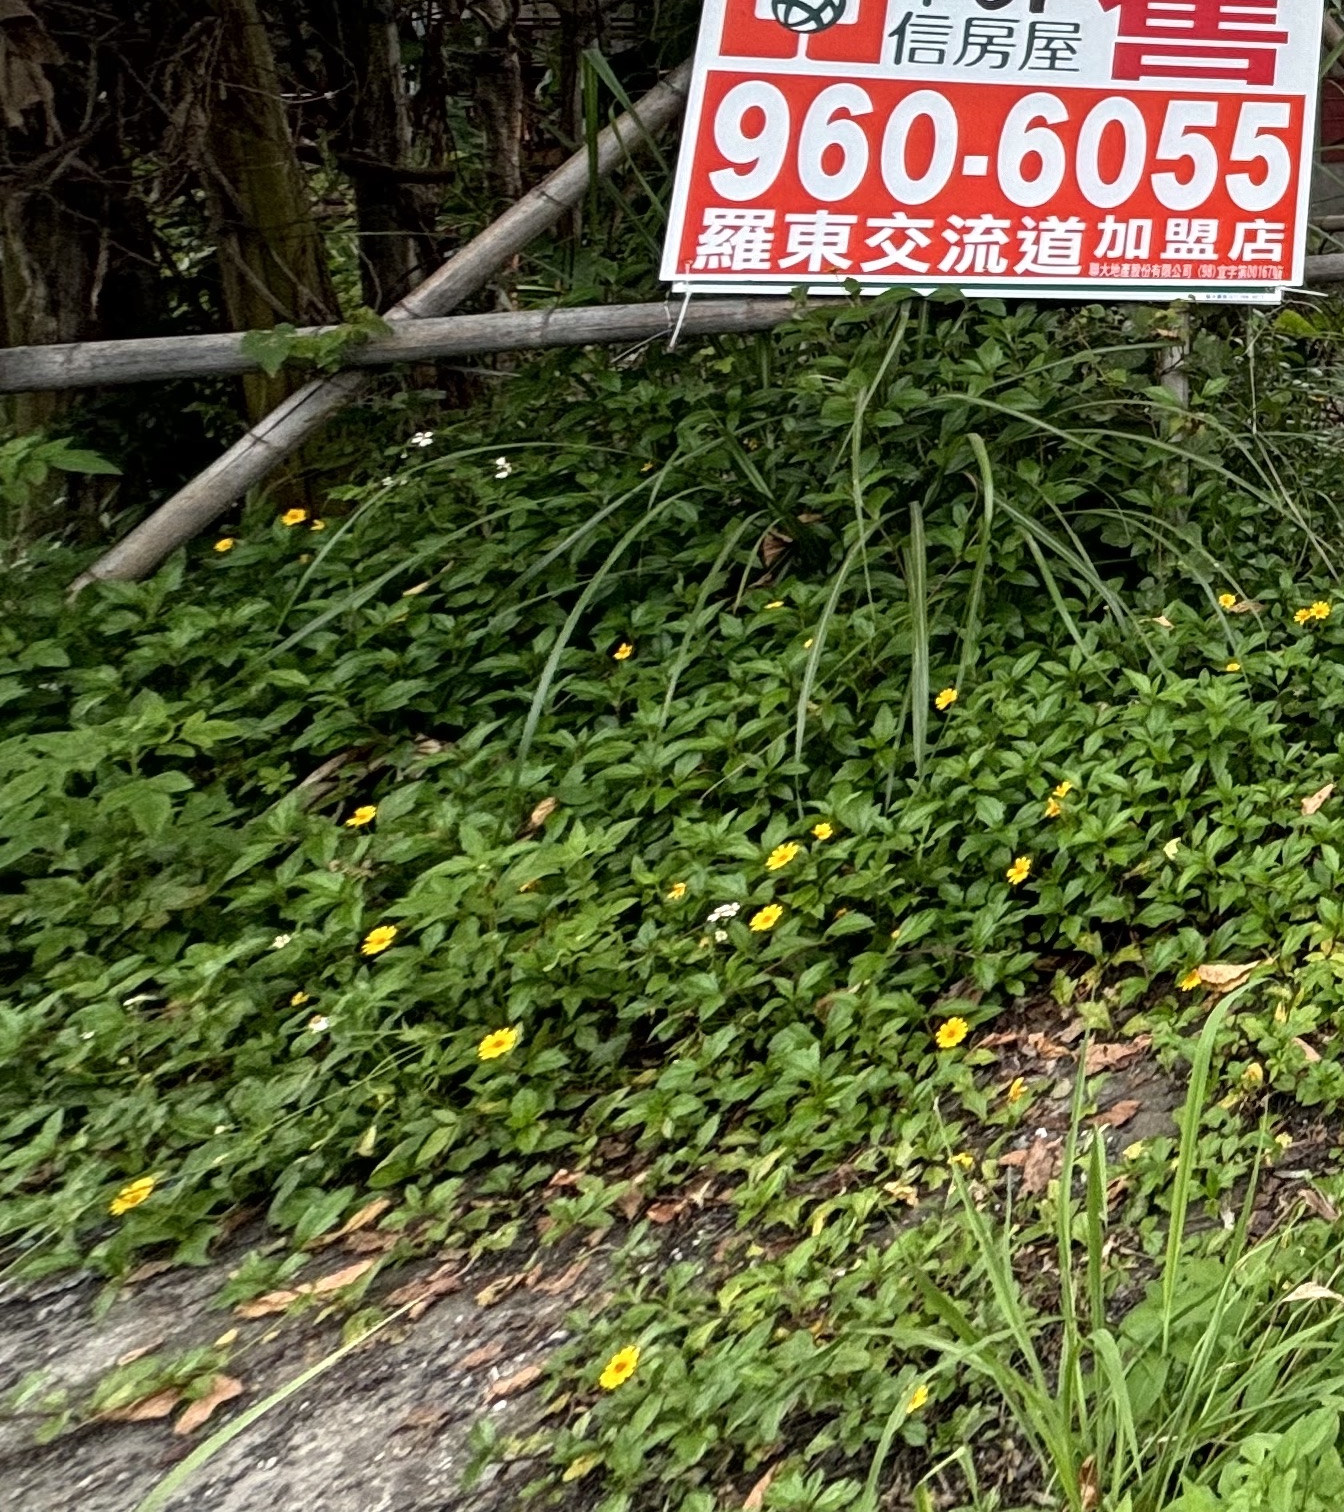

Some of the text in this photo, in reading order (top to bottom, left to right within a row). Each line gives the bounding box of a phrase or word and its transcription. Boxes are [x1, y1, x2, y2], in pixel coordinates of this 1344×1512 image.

[888, 12, 1082, 72] 信房屋
[708, 79, 1292, 212] 960-6055
[694, 207, 1286, 276] 羅東交流道加盟店
